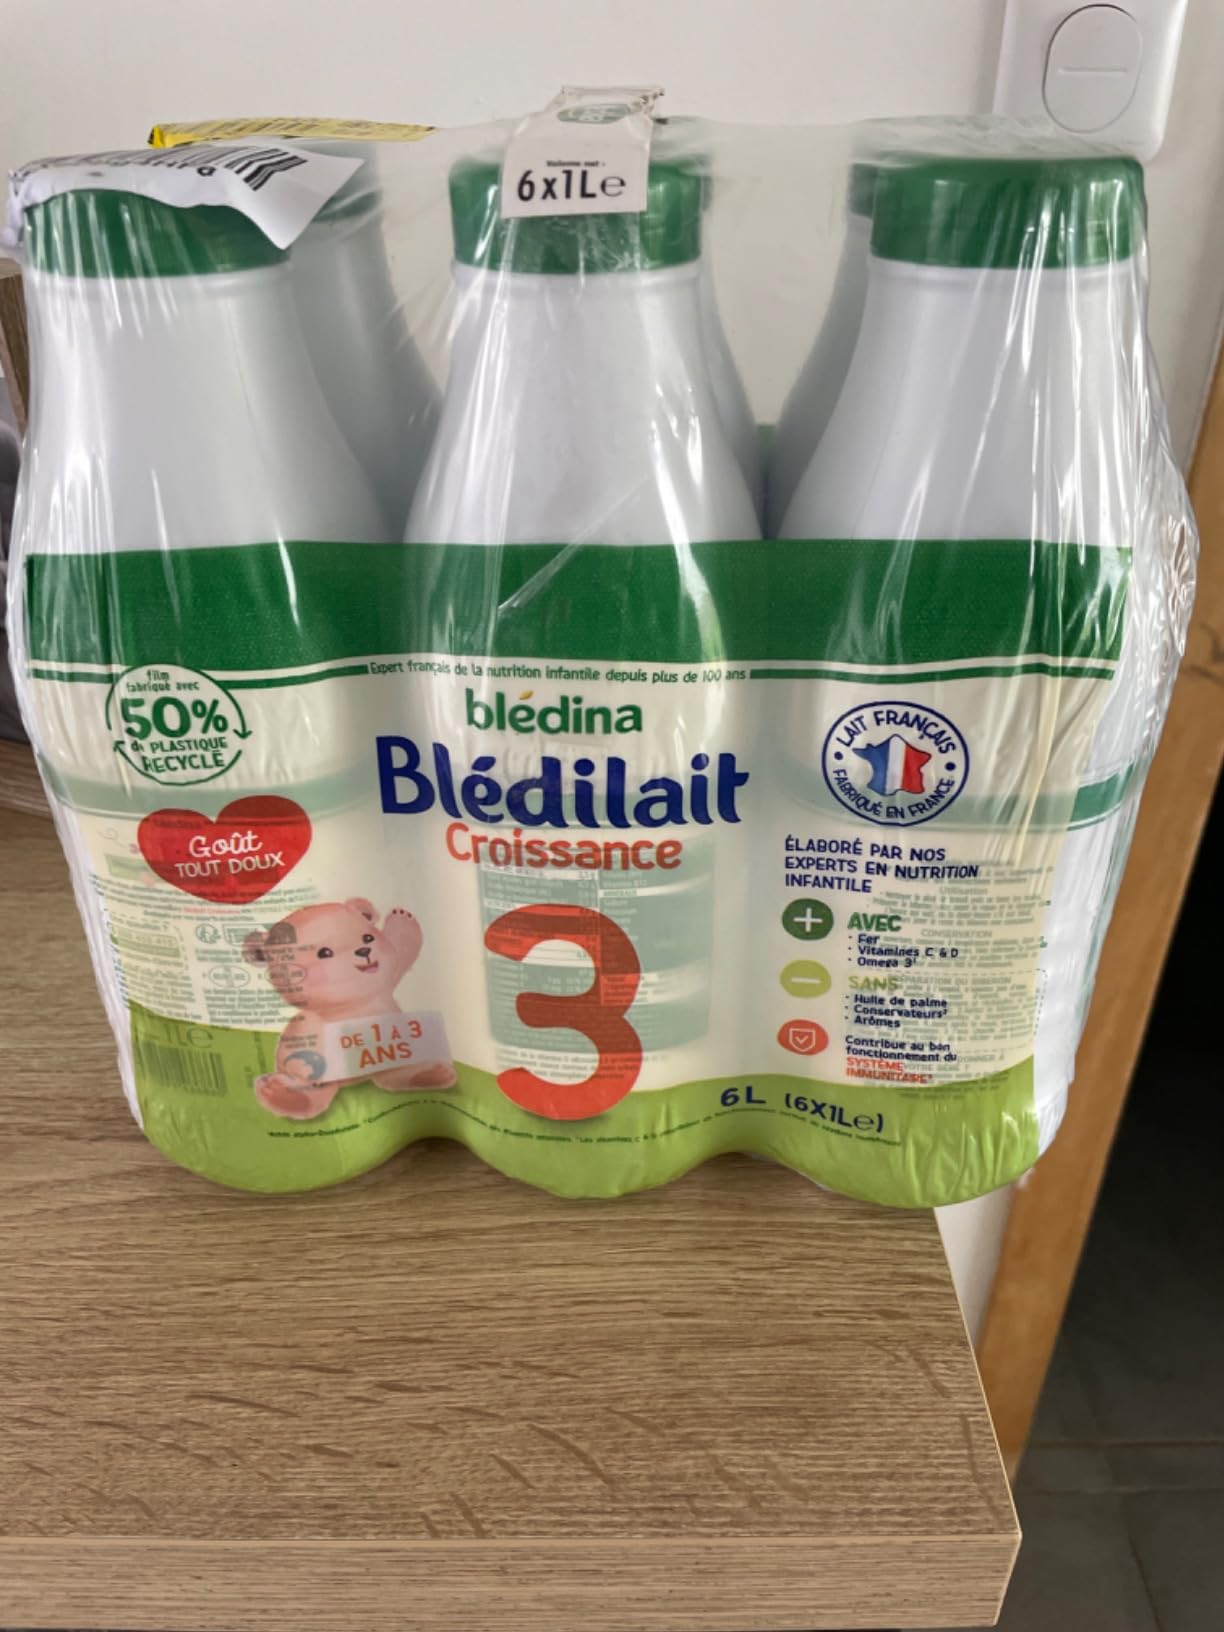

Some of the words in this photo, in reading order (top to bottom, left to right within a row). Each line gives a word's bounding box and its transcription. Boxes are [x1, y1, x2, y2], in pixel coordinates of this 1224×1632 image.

[147, 669, 170, 681] film
[370, 662, 403, 675] Expert
[407, 660, 451, 676] français
[454, 663, 468, 676] de
[472, 663, 482, 676] la
[487, 663, 542, 679] nutrition
[545, 665, 600, 681] infantile
[605, 668, 647, 683] depuis
[652, 670, 678, 684] plus
[683, 671, 698, 683] de
[702, 670, 721, 681] 100
[725, 670, 746, 680] ans
[176, 682, 200, 691] avec
[121, 696, 228, 740] 50%
[466, 687, 643, 734] blédina
[836, 715, 868, 748] LAIT
[873, 709, 956, 754] FRANÇAIS
[150, 737, 228, 753] PLASTIQUE
[376, 735, 750, 829] Blédilait
[833, 769, 882, 816] FABRIQUÉ
[886, 806, 905, 819] EN
[907, 778, 955, 817] FRANCE
[189, 830, 263, 858] Goût
[445, 823, 683, 871] Croissance
[785, 834, 863, 855] ÉLABORÉ
[870, 844, 903, 860] PAR
[910, 848, 946, 862] NOS
[174, 860, 221, 878] TOUT
[228, 851, 286, 875] DOUX
[785, 856, 857, 873] EXPERTS
[865, 861, 888, 876] EN
[894, 865, 980, 880] NUTRITION
[785, 874, 872, 893] INFANTILE
[847, 911, 902, 932] AVEC
[857, 933, 880, 944] Fer
[857, 956, 899, 968] Omega
[858, 945, 920, 957] Vitamines
[925, 947, 934, 957] C
[950, 948, 959, 958] D
[848, 975, 898, 991] SANS
[483, 903, 644, 1121] 3
[854, 994, 885, 1005] Huile
[890, 996, 905, 1006] de
[910, 998, 947, 1009] palme
[854, 1015, 900, 1028] Arômes
[340, 1034, 365, 1049] DE
[370, 1023, 382, 1042] 1
[408, 1020, 423, 1039] 3
[845, 1035, 906, 1050] Contribue
[910, 1042, 925, 1051] au
[929, 1041, 951, 1051] bon
[358, 1042, 413, 1068] ANS
[846, 1045, 940, 1061] fonctionnement
[944, 1053, 957, 1062] du
